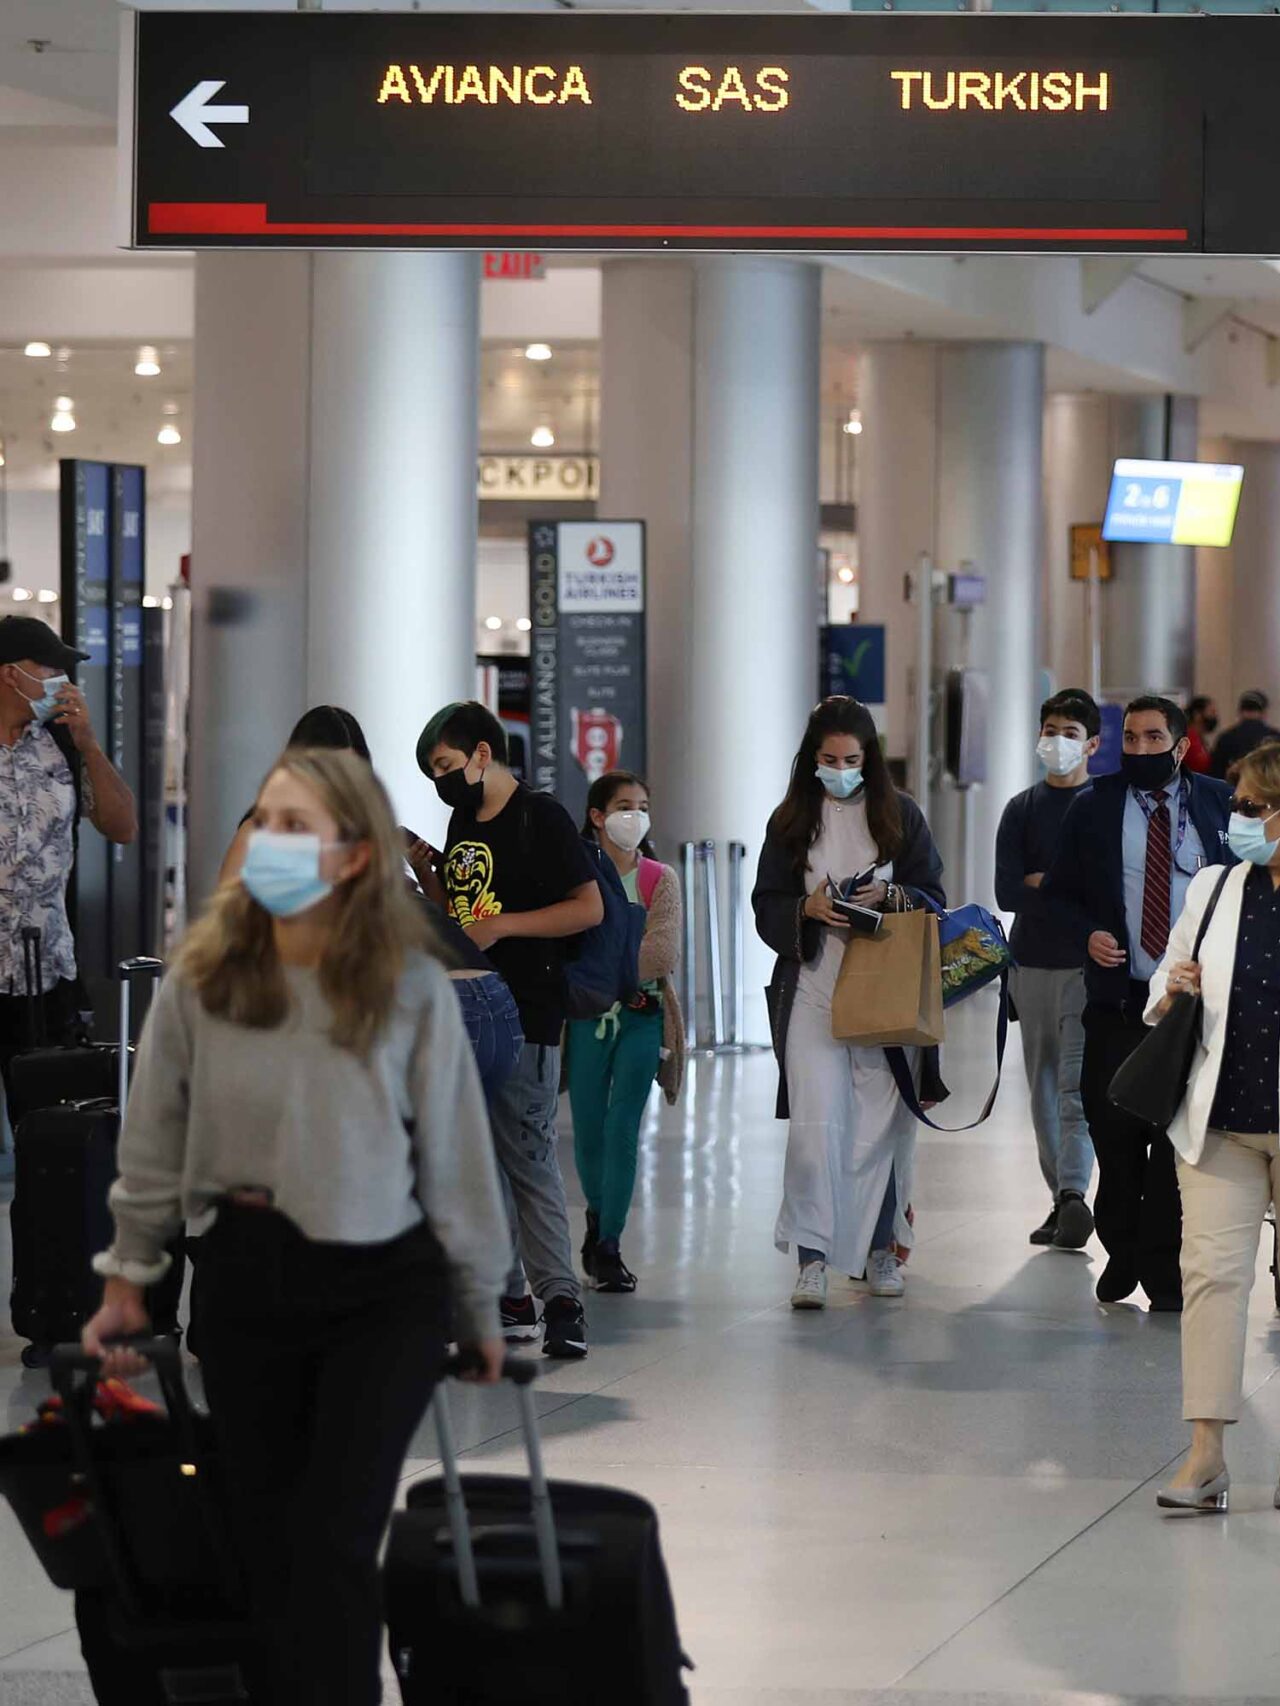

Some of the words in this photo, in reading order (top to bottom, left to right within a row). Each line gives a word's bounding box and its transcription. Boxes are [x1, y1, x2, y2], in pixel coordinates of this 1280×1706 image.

[377, 65, 593, 105] AVIANCA
[675, 66, 789, 111] SAS
[890, 71, 1108, 111] TURKISH
[535, 553, 556, 627] GOLD
[536, 634, 557, 758] ALLIANCE
